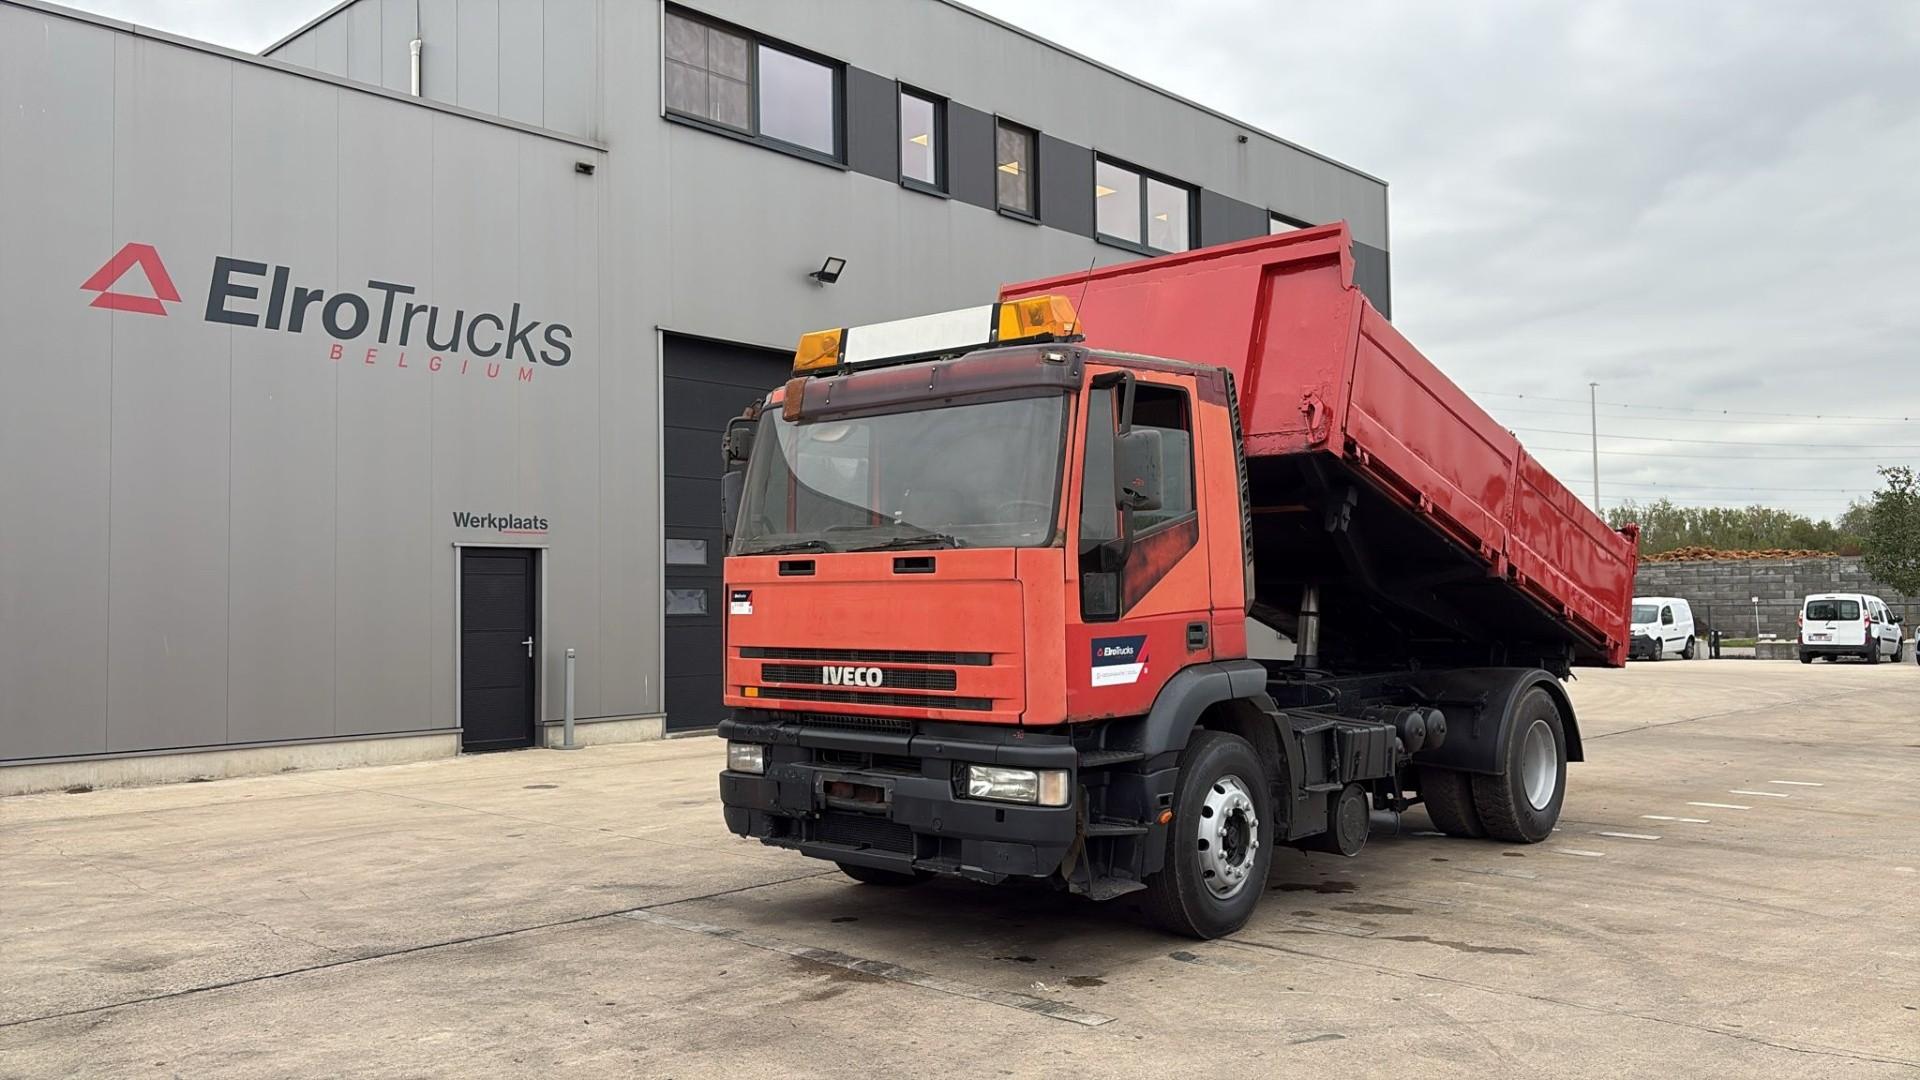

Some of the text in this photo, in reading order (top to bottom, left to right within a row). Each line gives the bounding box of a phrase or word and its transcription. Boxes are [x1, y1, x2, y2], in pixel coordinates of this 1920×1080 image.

[204, 255, 574, 367] ElroTrucks
[329, 343, 536, 383] BELGIUM
[452, 511, 549, 532] Werkplaats
[822, 665, 883, 687] IVECO
